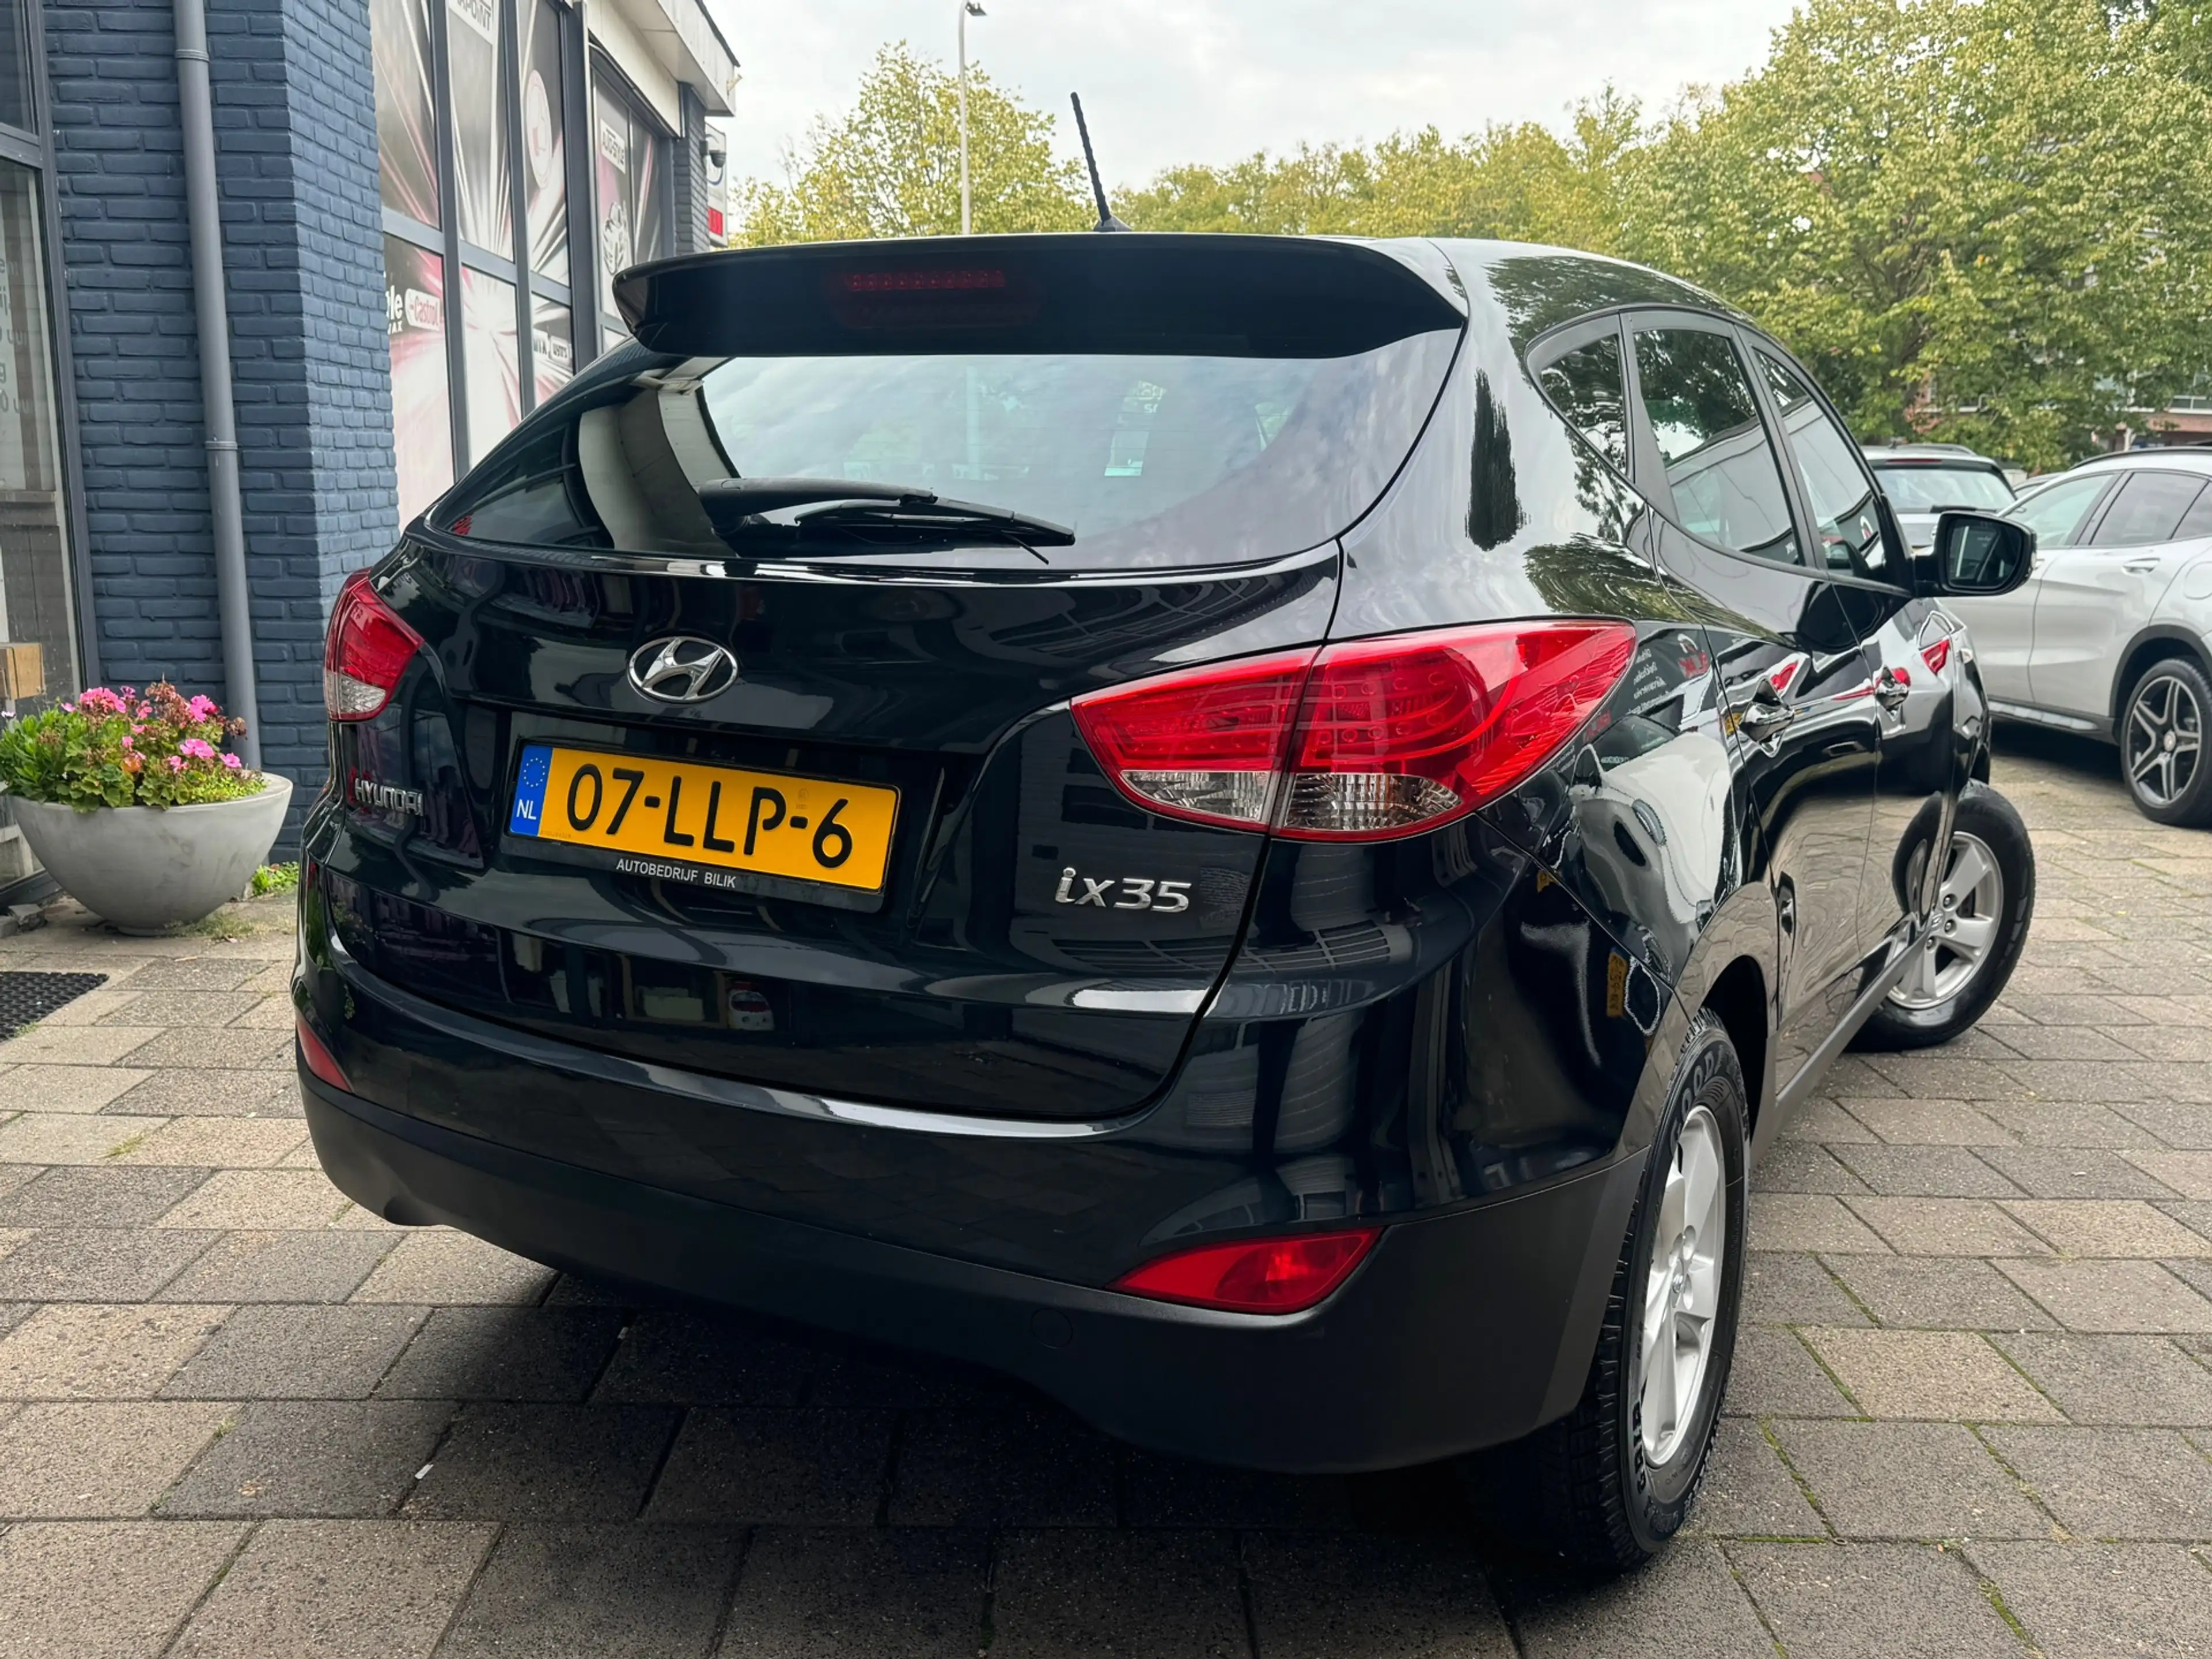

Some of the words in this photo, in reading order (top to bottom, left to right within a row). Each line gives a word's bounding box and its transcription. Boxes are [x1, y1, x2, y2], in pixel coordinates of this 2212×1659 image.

[354, 778, 423, 816] HYUNDAI
[516, 799, 537, 821] NL
[567, 763, 853, 868] 07-LLP-6
[616, 858, 698, 882] AUTOBEDRIJF
[704, 872, 737, 889] BILIK
[1055, 867, 1192, 912] ix35
